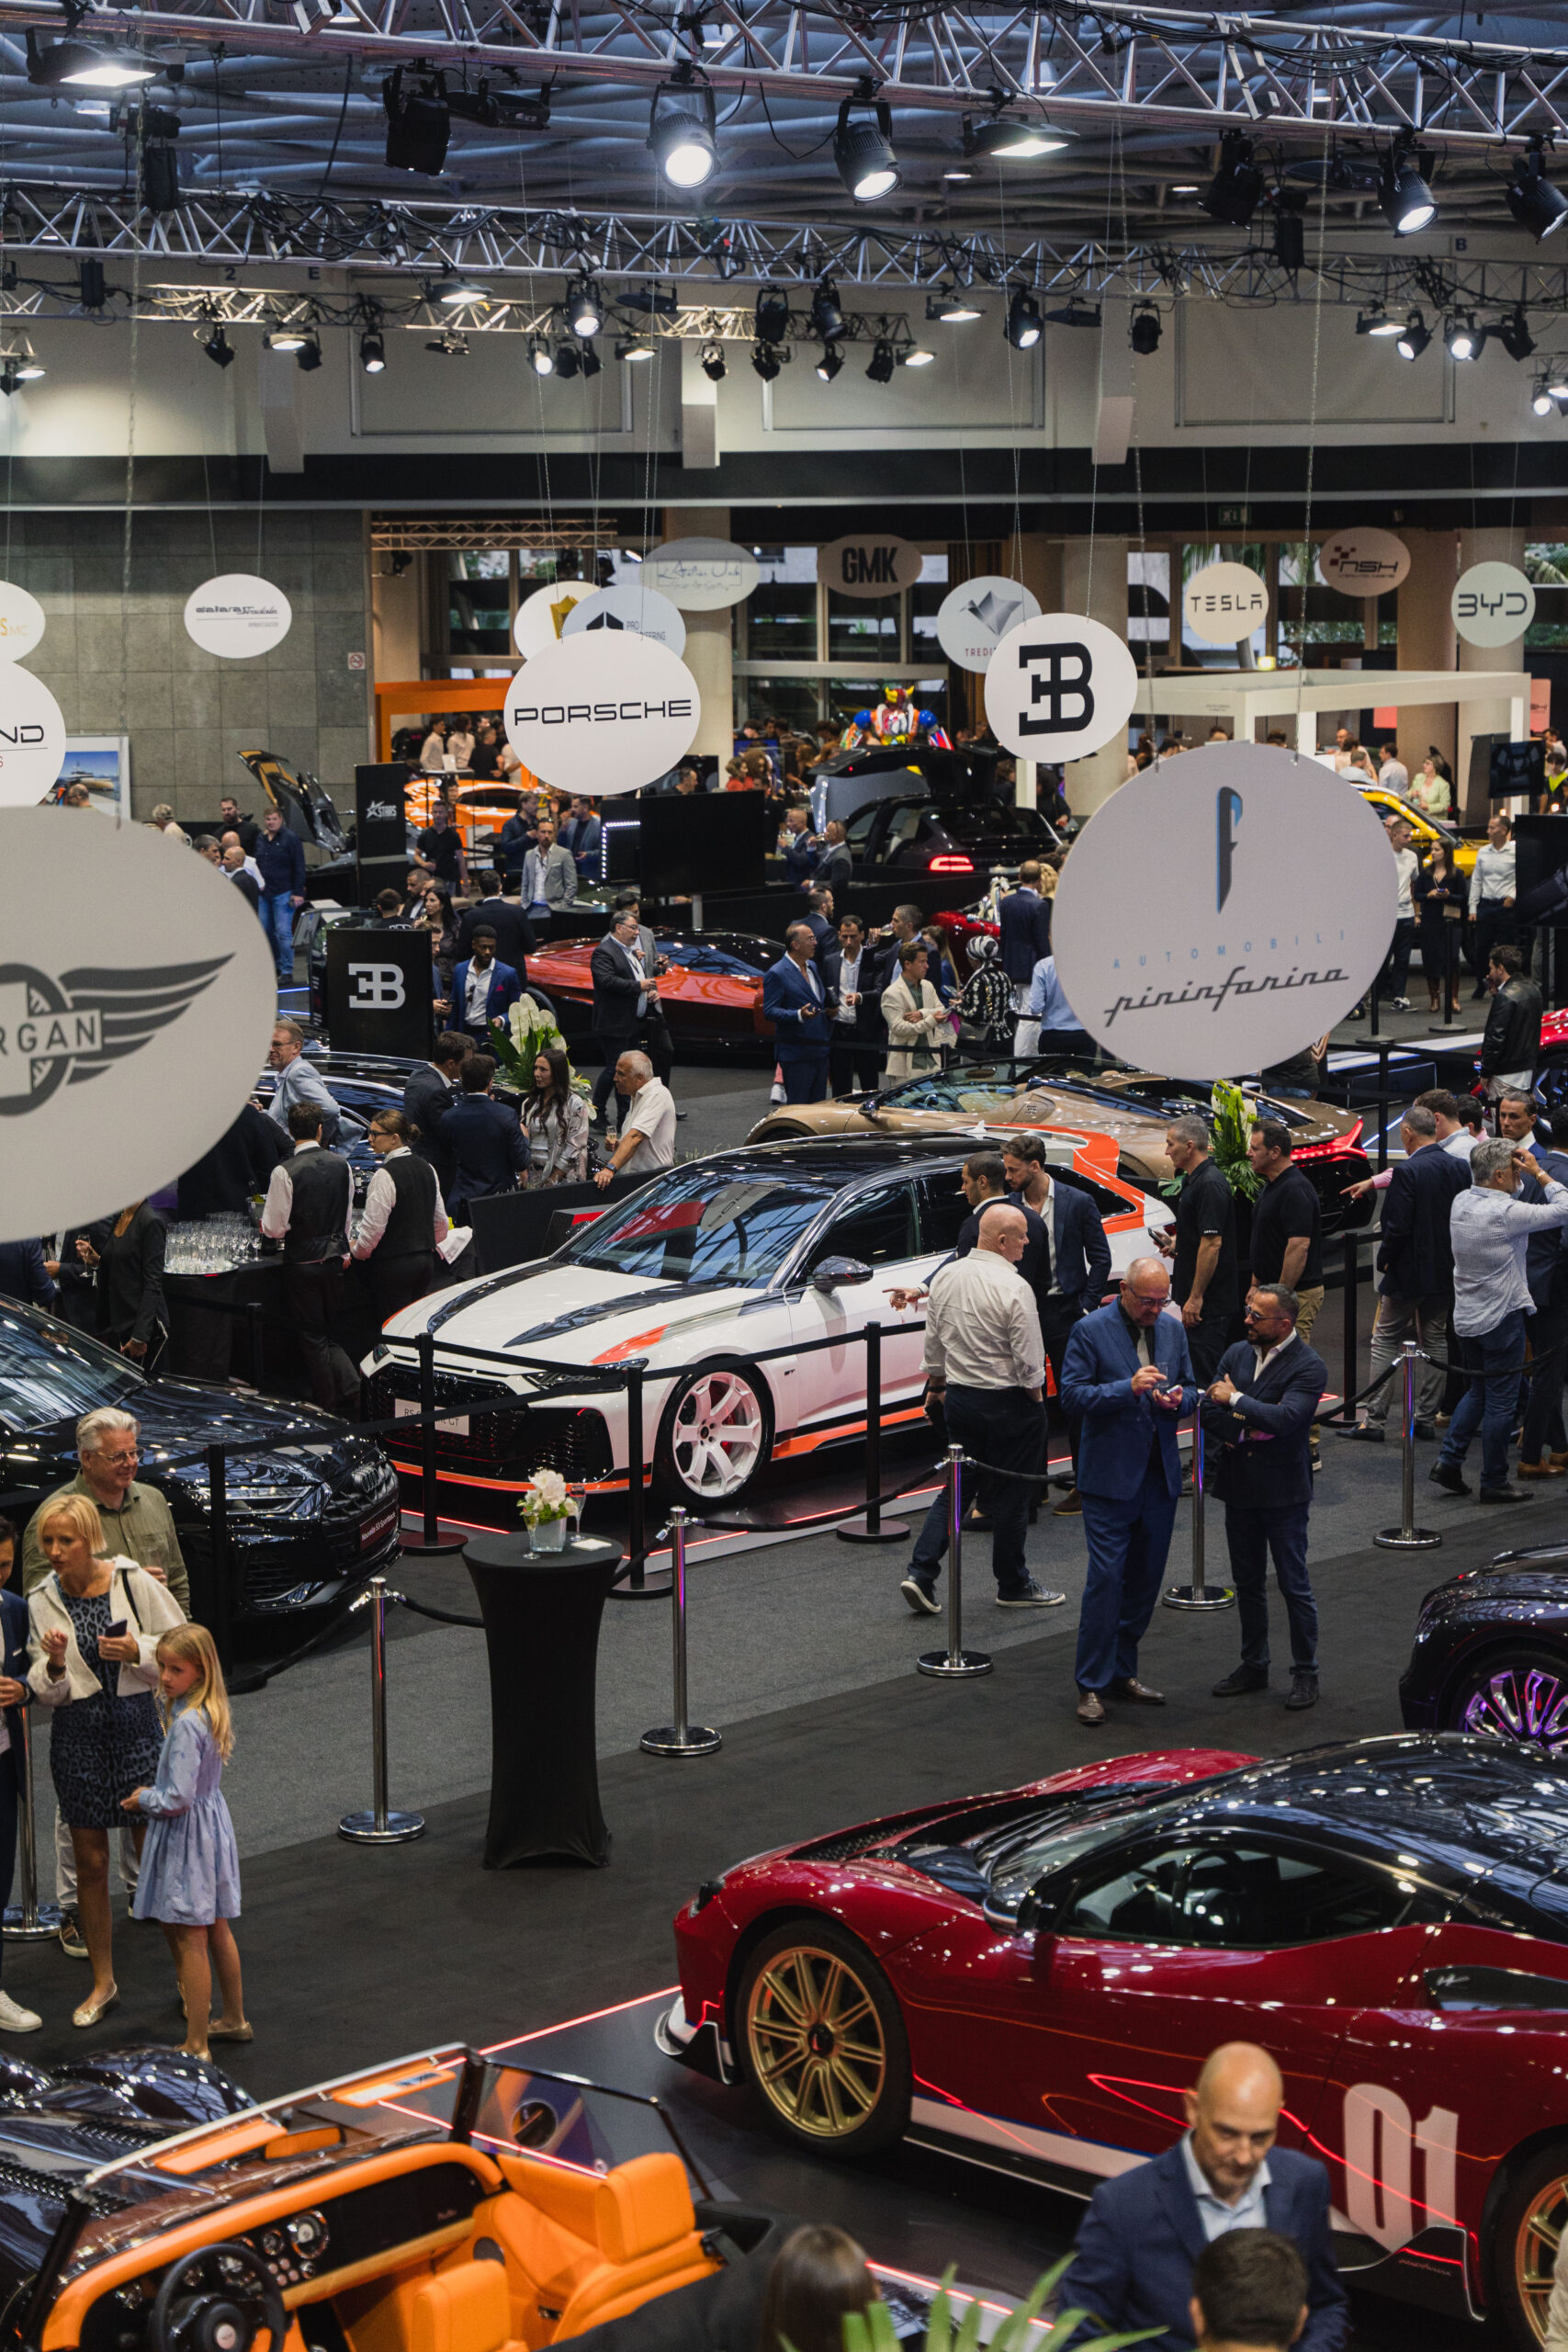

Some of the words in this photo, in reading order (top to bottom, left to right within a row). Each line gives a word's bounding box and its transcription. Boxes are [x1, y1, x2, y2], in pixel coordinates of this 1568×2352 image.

[225, 266, 236, 281] 2
[309, 266, 321, 280] E
[842, 547, 898, 584] GMK
[1190, 594, 1262, 613] TESLA
[1458, 593, 1528, 617] BYD
[964, 647, 993, 658] TREDI
[514, 699, 691, 727] PORSCHE
[0, 725, 44, 743] ND
[1113, 930, 1344, 969] AUTOMOBILI
[1104, 966, 1349, 1027] pininfarina
[1344, 2083, 1459, 2253] 01
